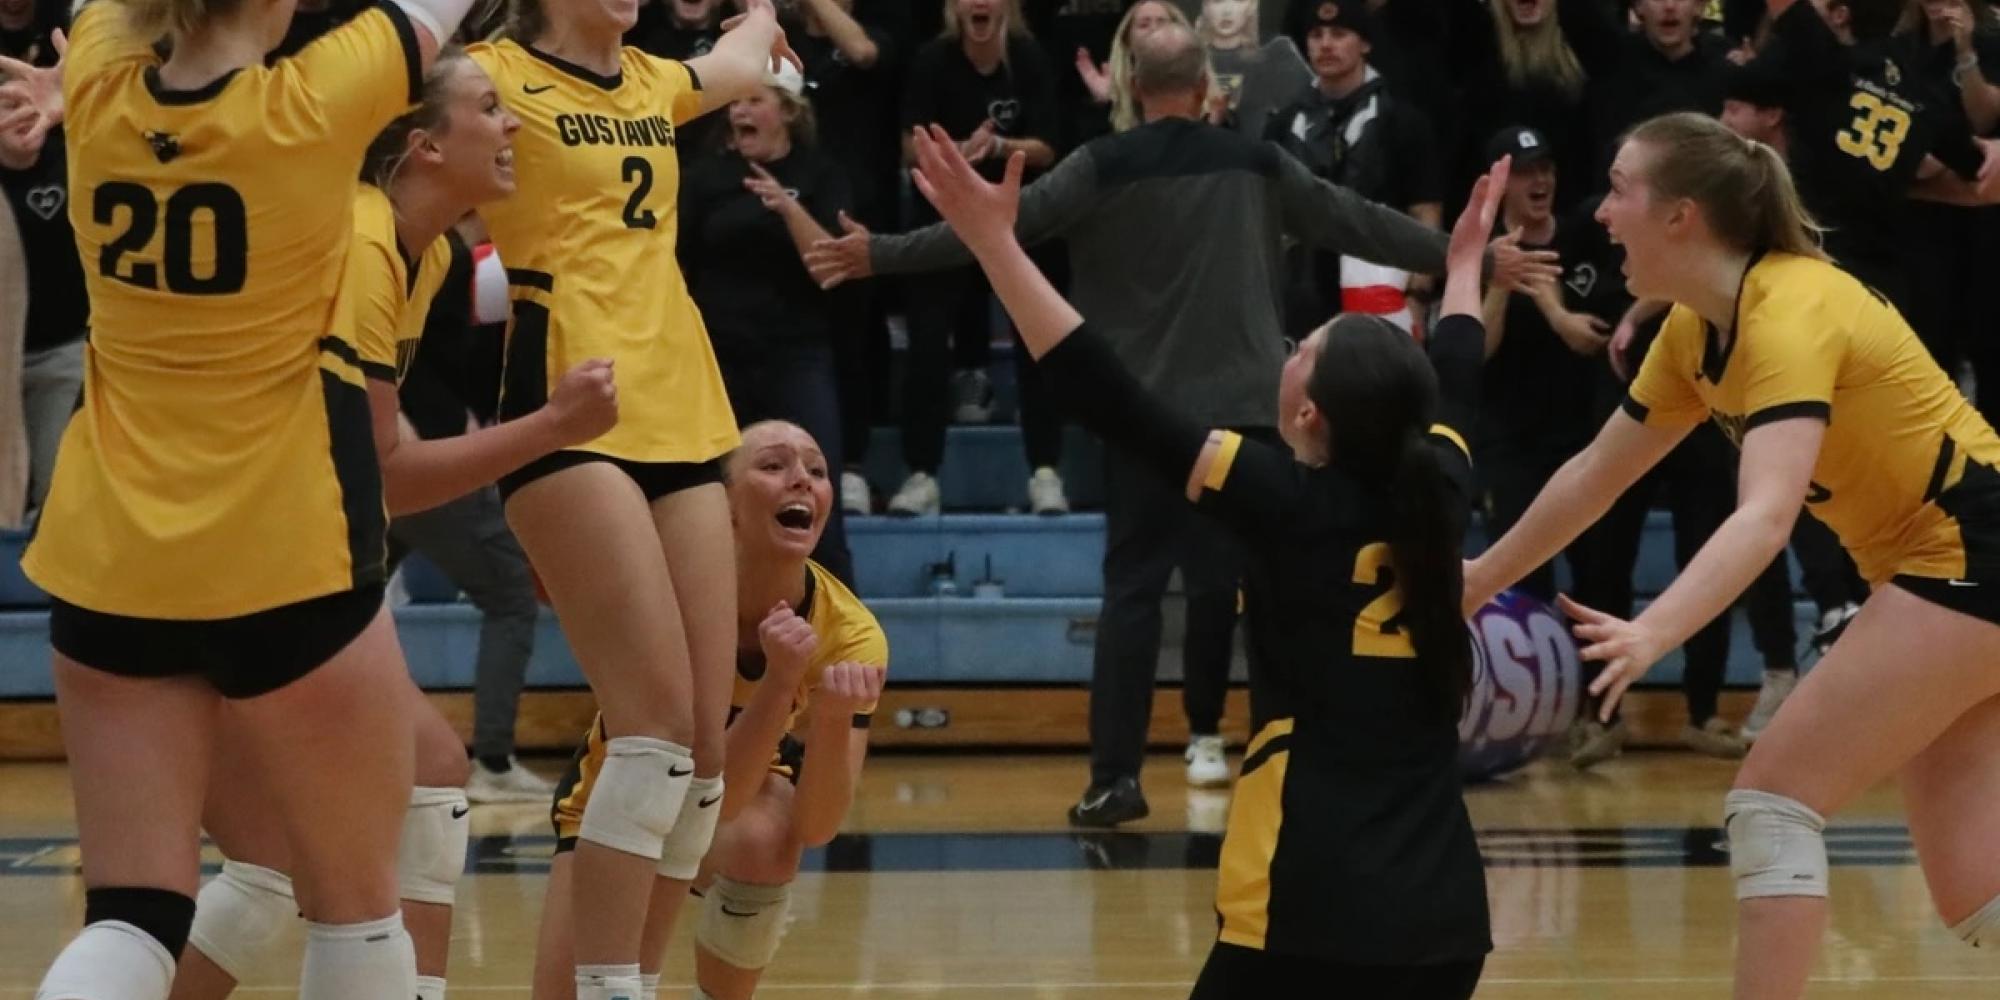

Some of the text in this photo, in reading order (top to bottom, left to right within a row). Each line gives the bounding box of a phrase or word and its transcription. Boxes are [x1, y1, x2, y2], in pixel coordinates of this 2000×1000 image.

[1836, 91, 1911, 171] 33
[93, 181, 247, 294] 20
[621, 155, 656, 229] 2
[1352, 541, 1417, 658] 2
